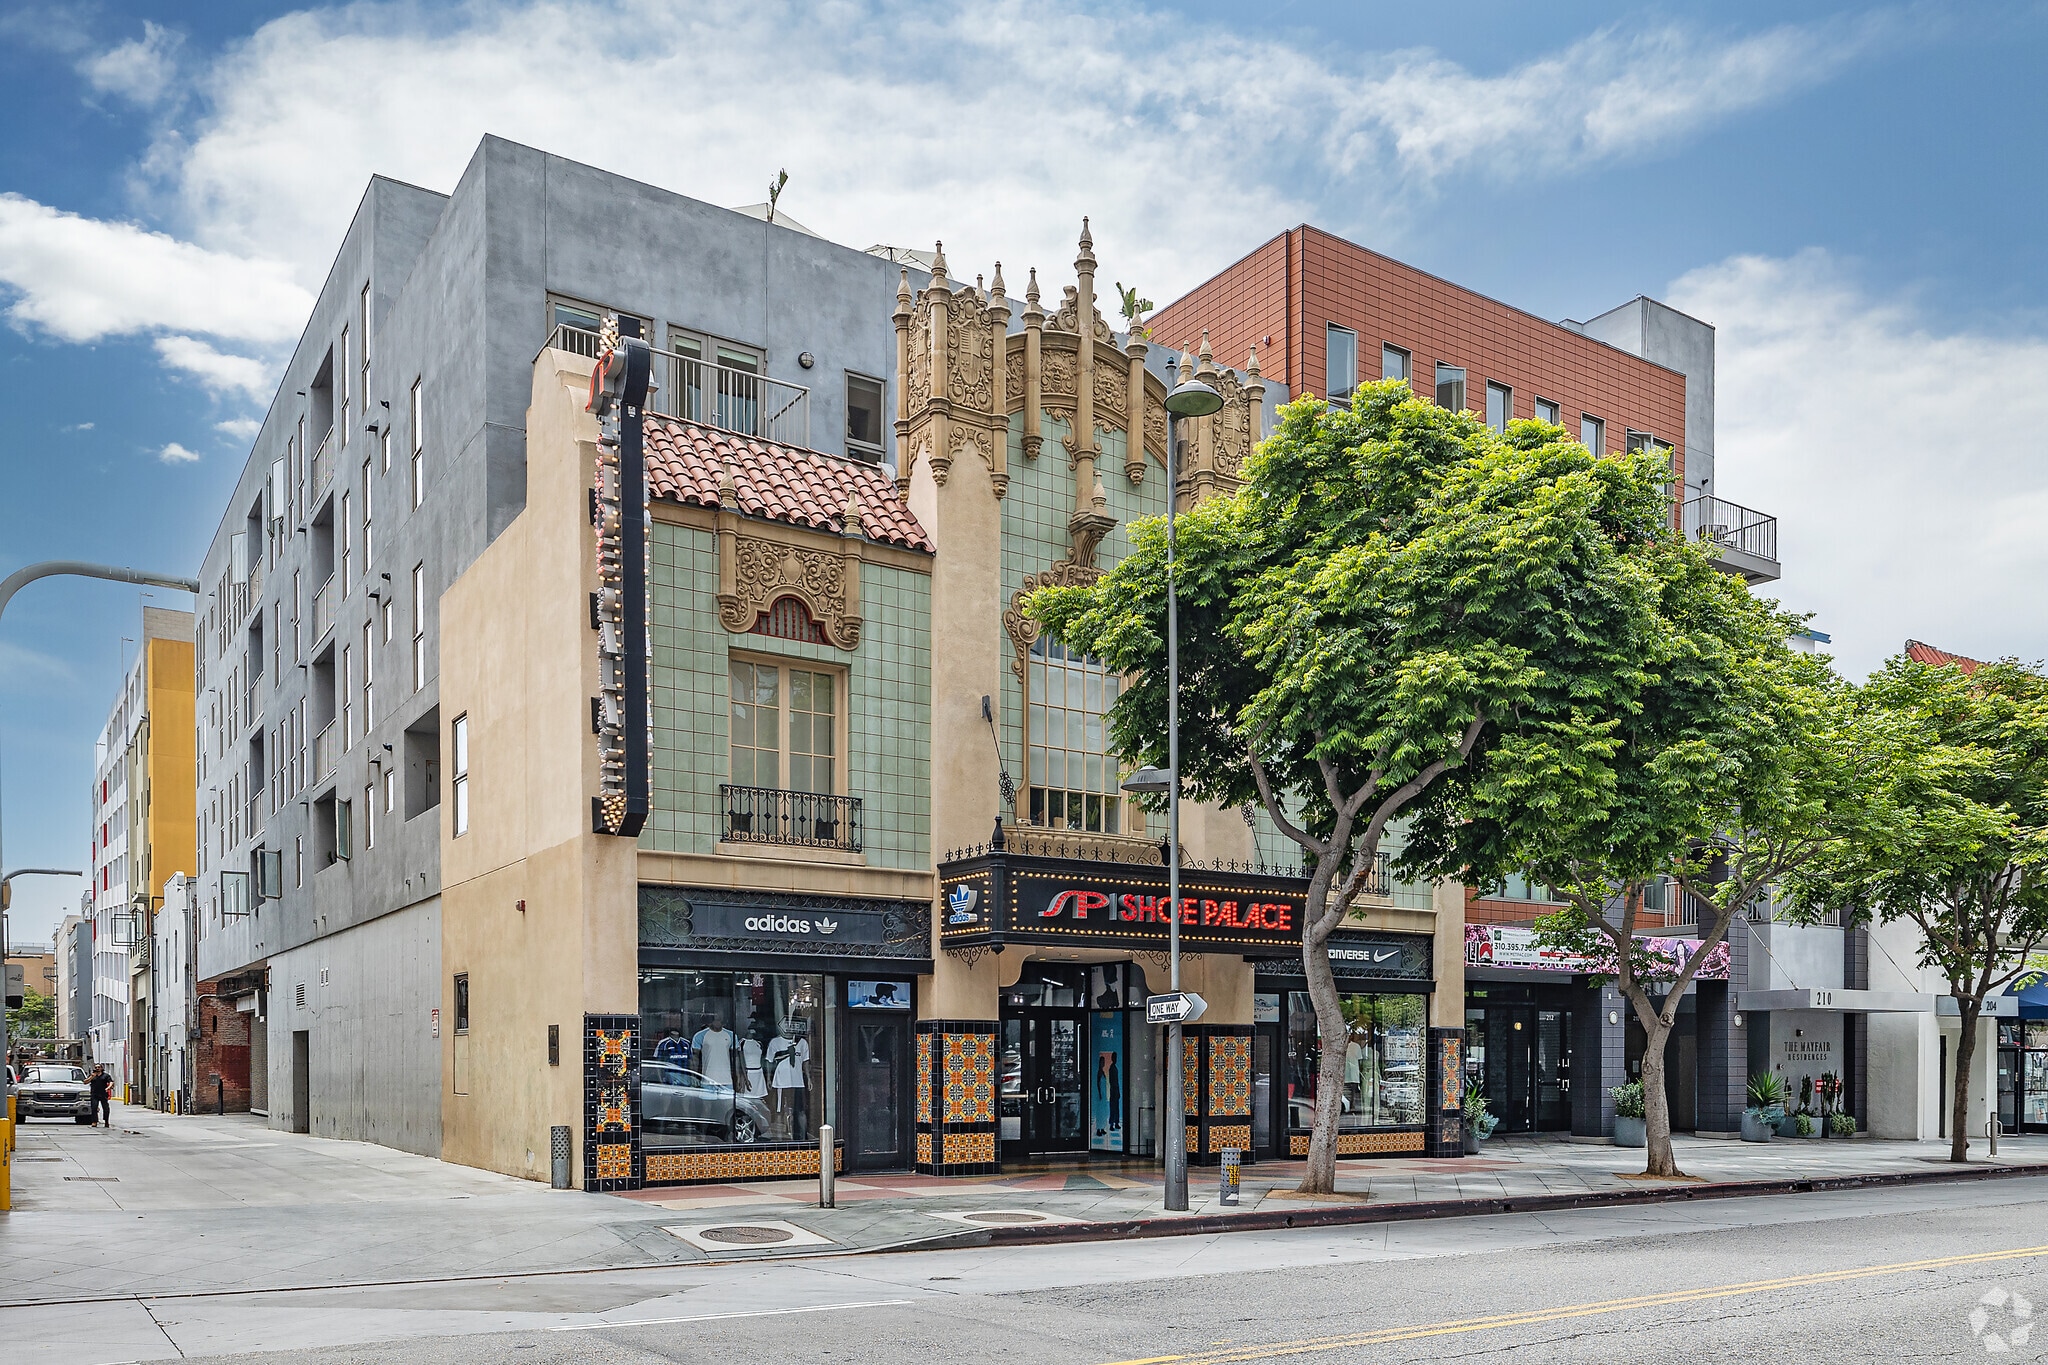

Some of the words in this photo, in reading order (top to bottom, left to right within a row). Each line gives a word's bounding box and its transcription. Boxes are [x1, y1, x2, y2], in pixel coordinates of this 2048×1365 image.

[949, 913, 970, 924] adidas
[1119, 893, 1198, 925] SHOE
[1202, 899, 1292, 931] PALACE
[744, 914, 811, 934] adidas
[1327, 948, 1370, 961] ONVERSE
[1816, 992, 1832, 1006] 210
[1151, 1004, 1165, 1015] ONE
[1165, 1002, 1180, 1014] WAY
[1986, 1001, 1997, 1011] 204
[1783, 1041, 1798, 1052] THE
[1800, 1041, 1831, 1052] MAYFAIR
[1787, 1053, 1828, 1061] RESIDENCES
